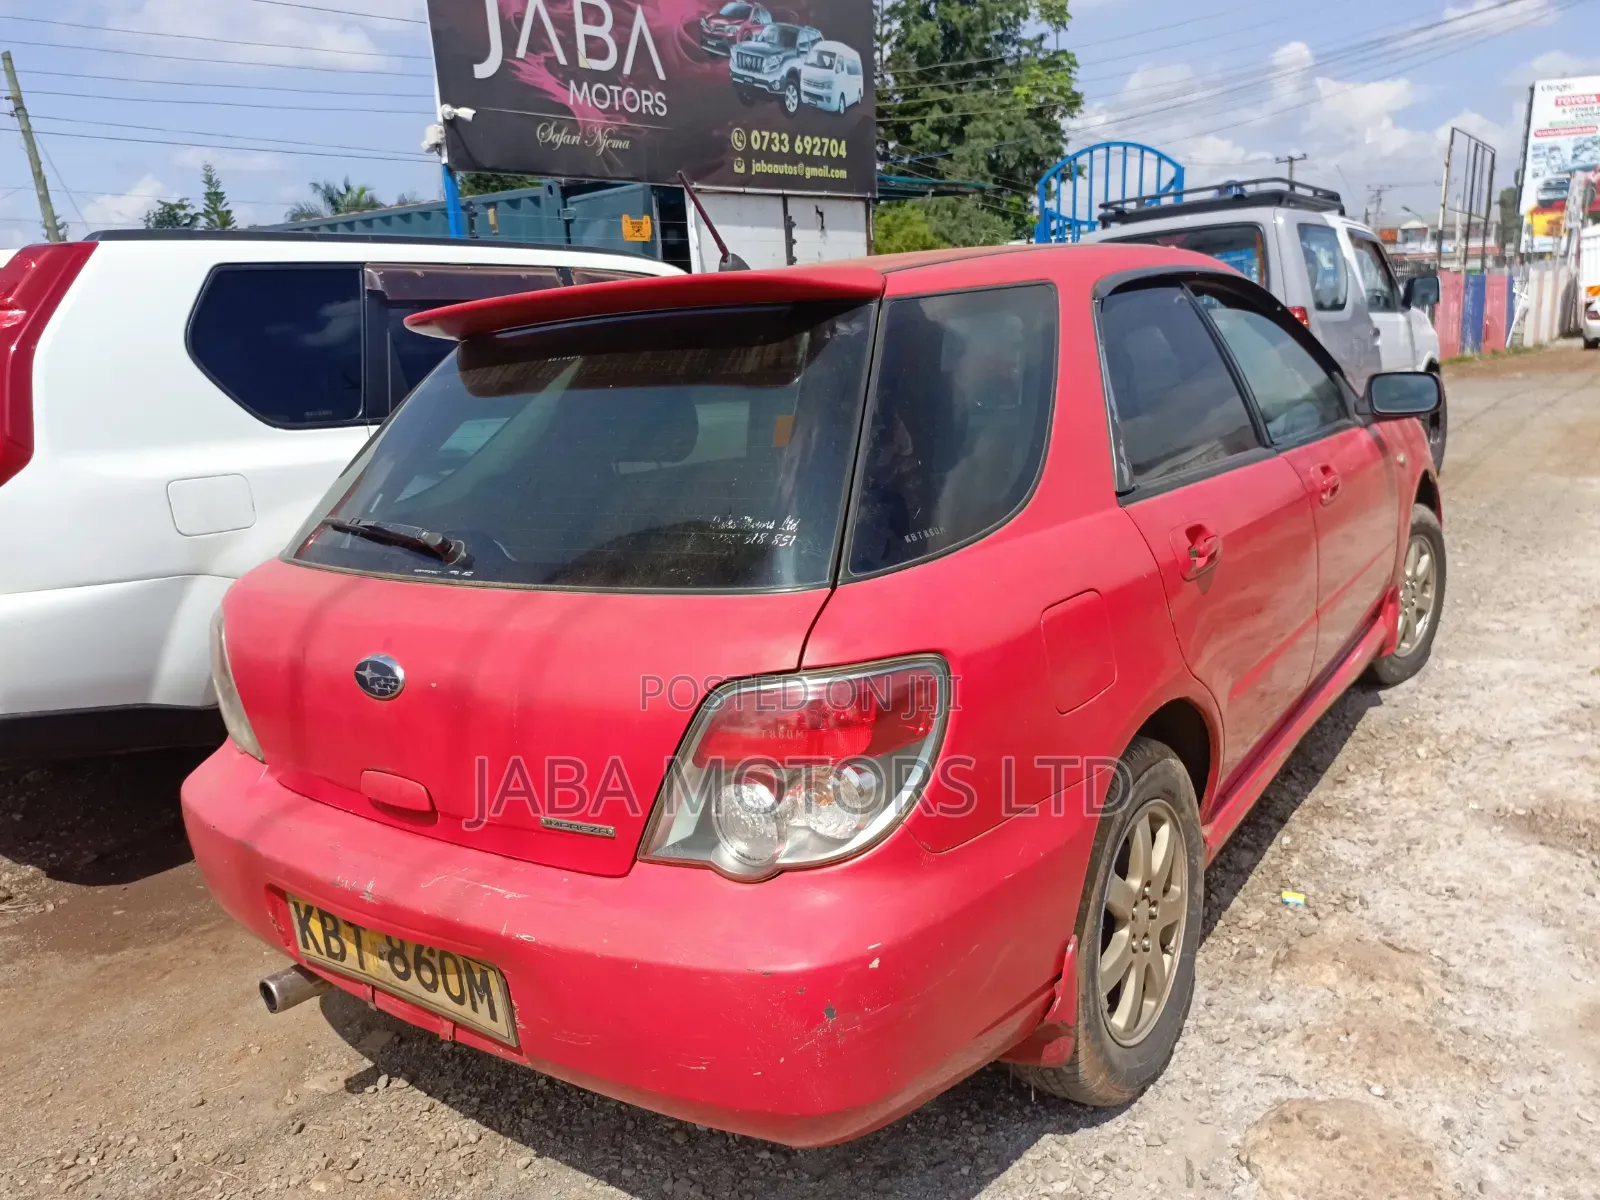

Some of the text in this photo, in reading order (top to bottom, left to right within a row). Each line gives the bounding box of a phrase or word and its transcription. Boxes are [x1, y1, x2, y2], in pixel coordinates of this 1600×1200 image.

[473, 0, 666, 80] JABA
[568, 79, 668, 117] MOTORS
[536, 121, 632, 156] Safari Njema
[750, 129, 847, 159] 0733 692704
[751, 158, 847, 179] jabaautos@gmail.com
[545, 820, 609, 834] IMPREZA
[292, 900, 498, 1023] KBT 860M
